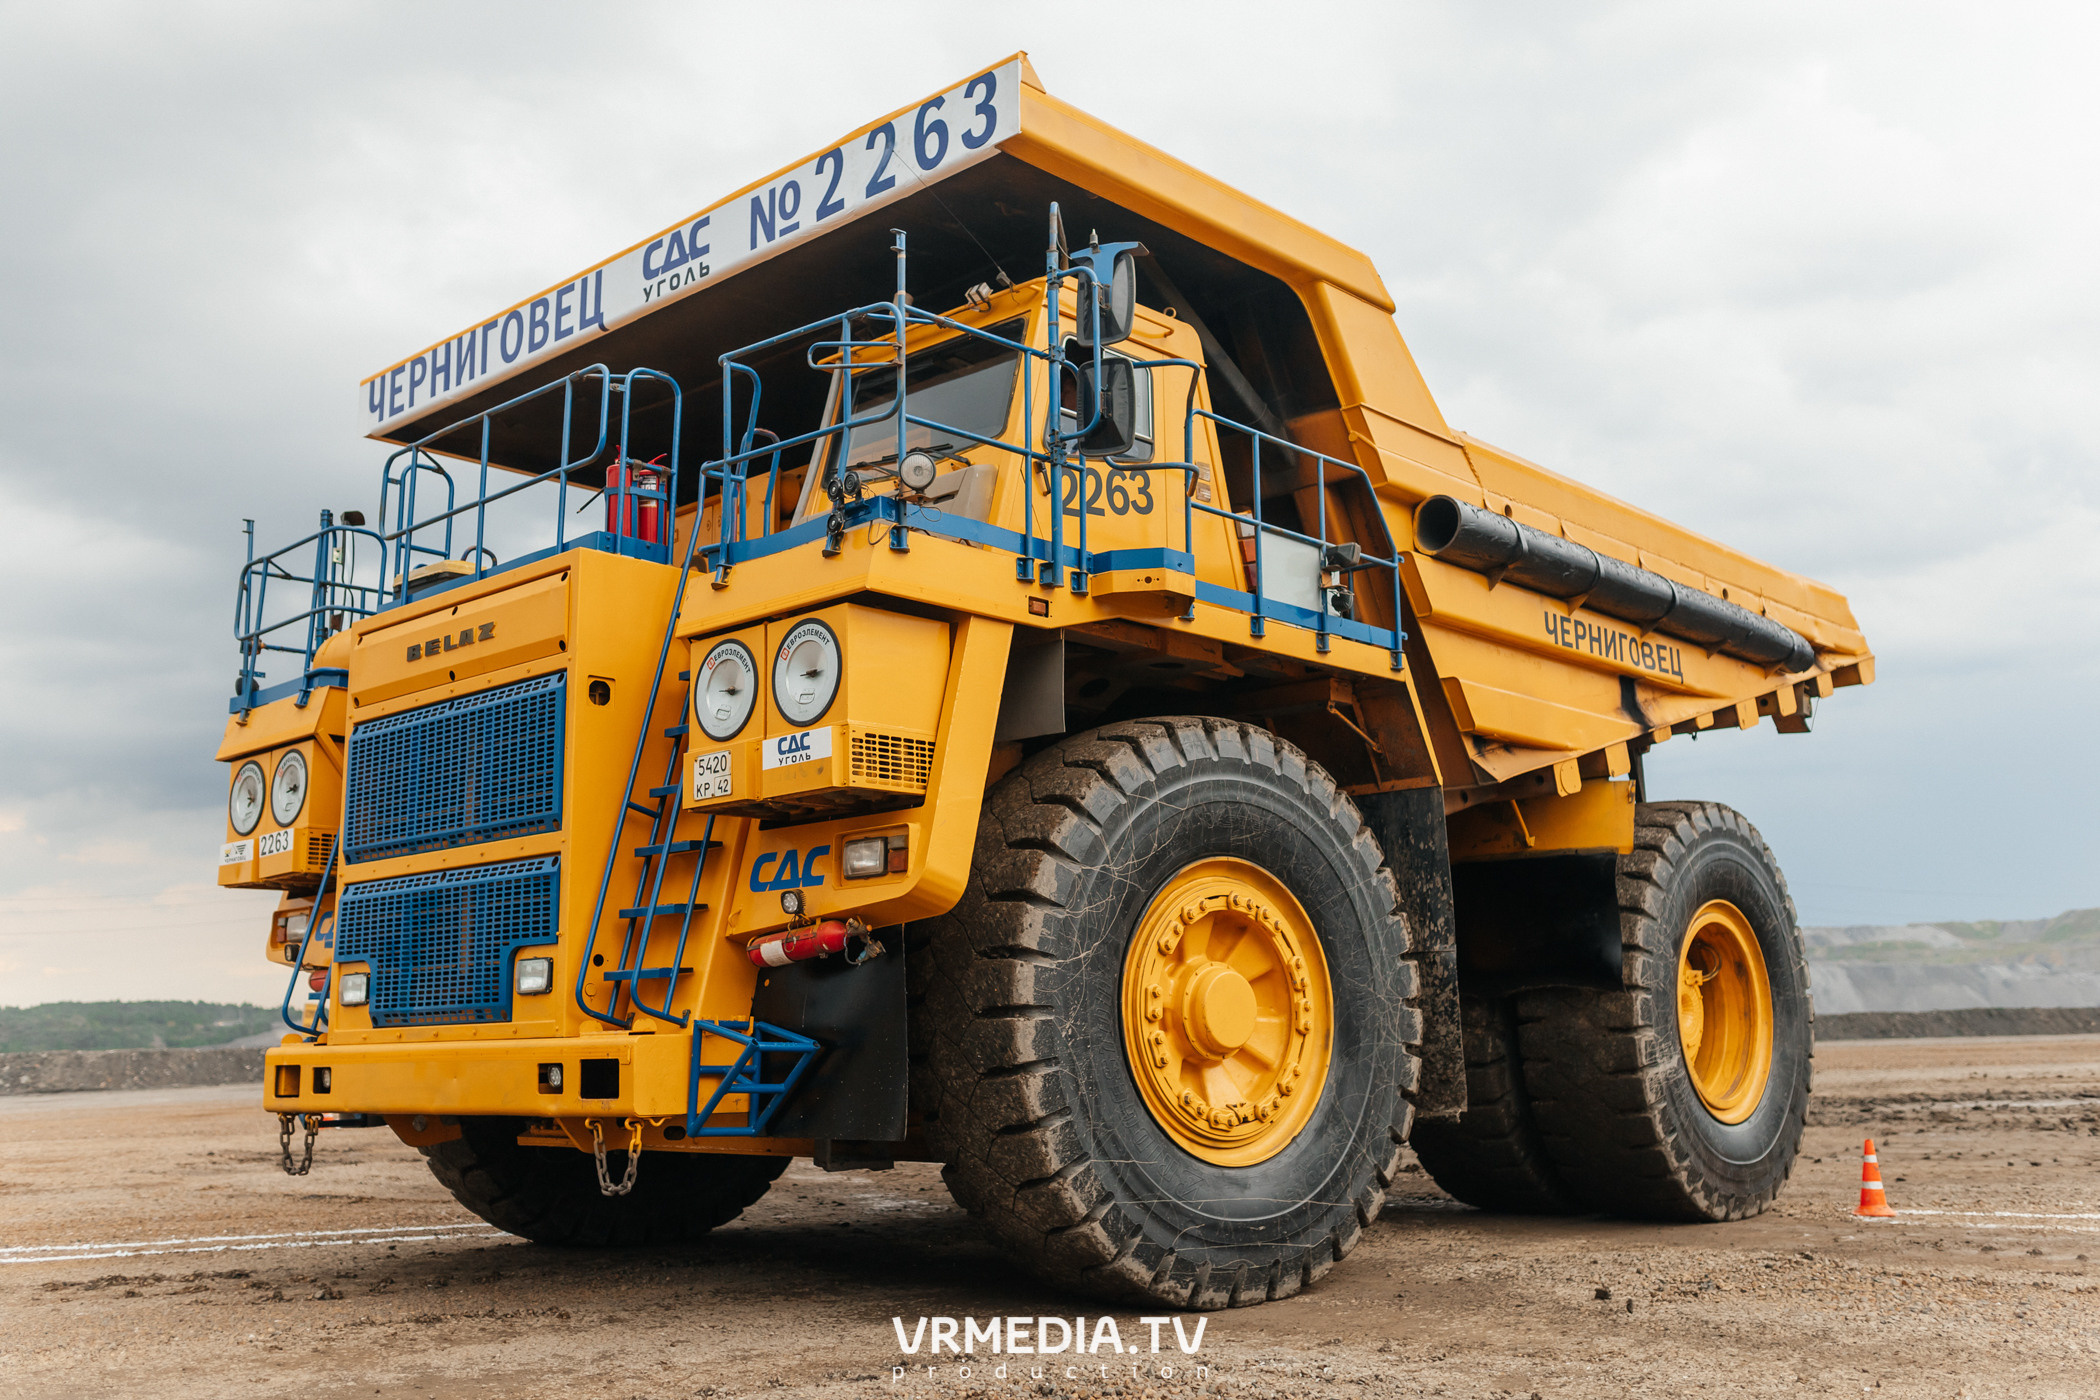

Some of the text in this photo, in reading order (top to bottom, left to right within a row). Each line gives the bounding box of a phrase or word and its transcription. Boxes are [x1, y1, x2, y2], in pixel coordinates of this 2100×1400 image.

[643, 215, 710, 280] СДС
[643, 262, 710, 303] УГОЛЬ
[369, 269, 609, 422] ЧЕРНИГОВЕЦ
[1061, 467, 1154, 517] 2263
[407, 621, 496, 662] BELAZ
[787, 628, 830, 650] ЕВРОЭЛЕМЕНТ
[1544, 611, 1684, 684] ЧЕРНИГОВЕЦ
[714, 648, 751, 673] ЕВРОЭЛЕМЕНТ
[778, 732, 811, 755] СДС
[778, 752, 811, 766] УГОЛЬ
[698, 754, 727, 776] 5420
[717, 778, 729, 793] 42
[261, 830, 289, 856] 2263
[750, 845, 831, 892] СДС
